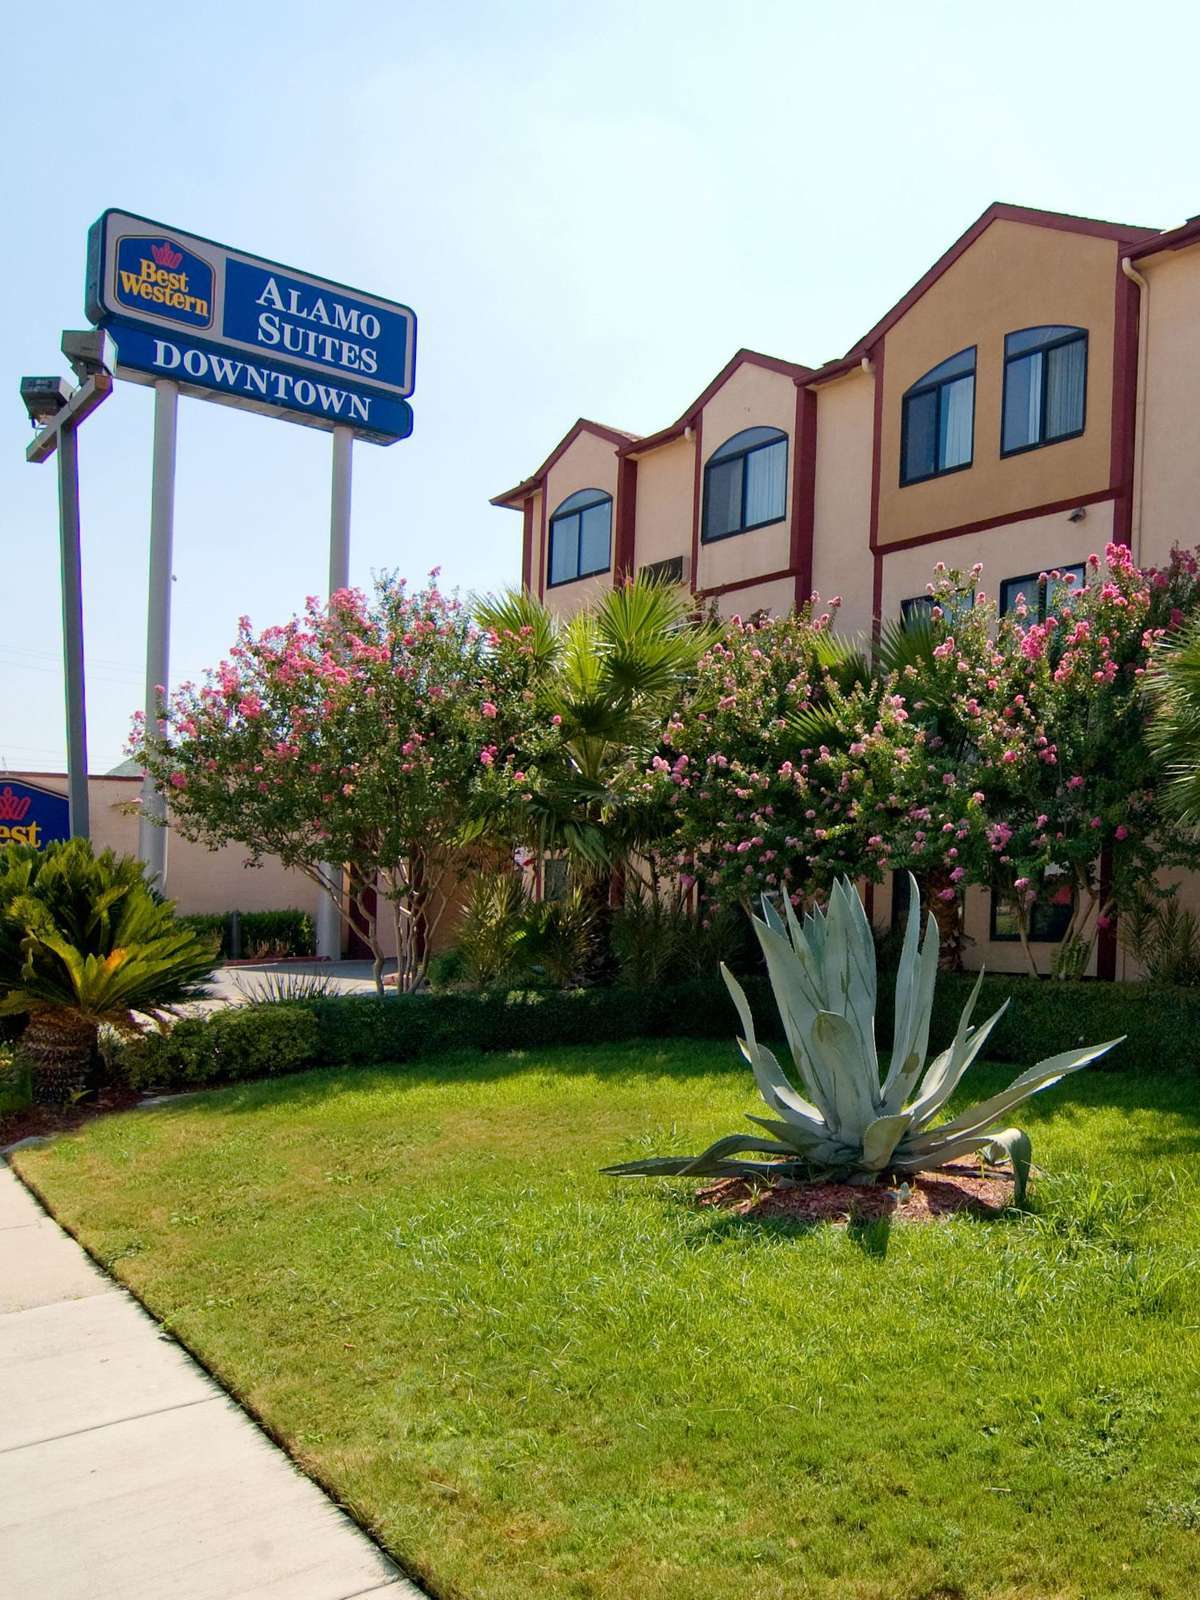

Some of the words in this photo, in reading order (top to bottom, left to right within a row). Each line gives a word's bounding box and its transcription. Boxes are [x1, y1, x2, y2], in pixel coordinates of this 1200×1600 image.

[120, 270, 208, 317] Western
[139, 258, 189, 292] Best
[256, 277, 381, 340] ALAMO
[257, 313, 378, 374] SUITES
[153, 340, 372, 422] DOWNTOWN
